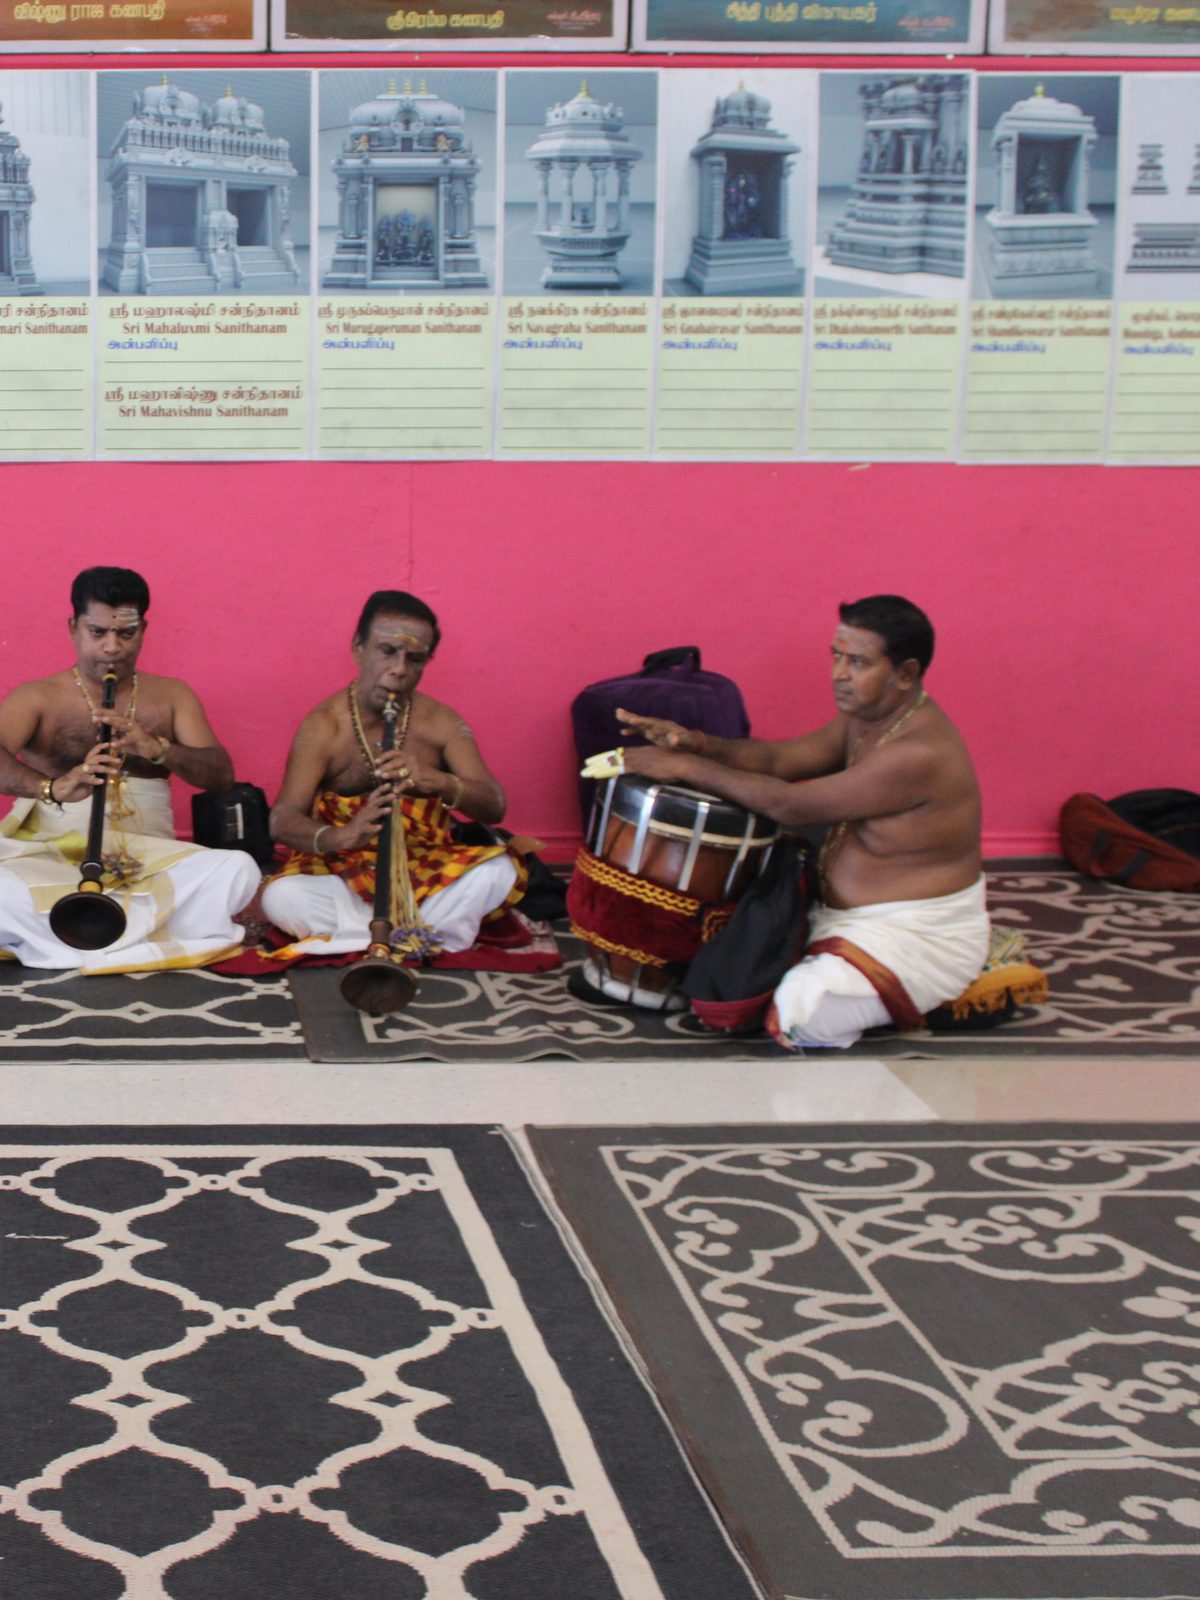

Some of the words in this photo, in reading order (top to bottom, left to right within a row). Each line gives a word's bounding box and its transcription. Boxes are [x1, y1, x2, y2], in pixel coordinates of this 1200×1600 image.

[70, 4, 105, 21] ராஜ
[110, 0, 166, 20] கணபதி
[450, 10, 505, 29] கணபதி
[26, 322, 88, 334] Sanithanam
[123, 323, 140, 334] Sri
[144, 322, 210, 334] Mahaluxmi
[215, 322, 287, 334] Sanithanam
[326, 322, 339, 334] Sri
[425, 321, 482, 333] Sanithanam
[508, 322, 522, 334] Sri
[107, 338, 178, 351] அன்பளிப்பு
[323, 337, 395, 350] அன்பளிப்பு
[119, 405, 136, 417] Sri
[140, 405, 212, 417] Mahavishnu
[217, 405, 288, 417] Sanithanam
